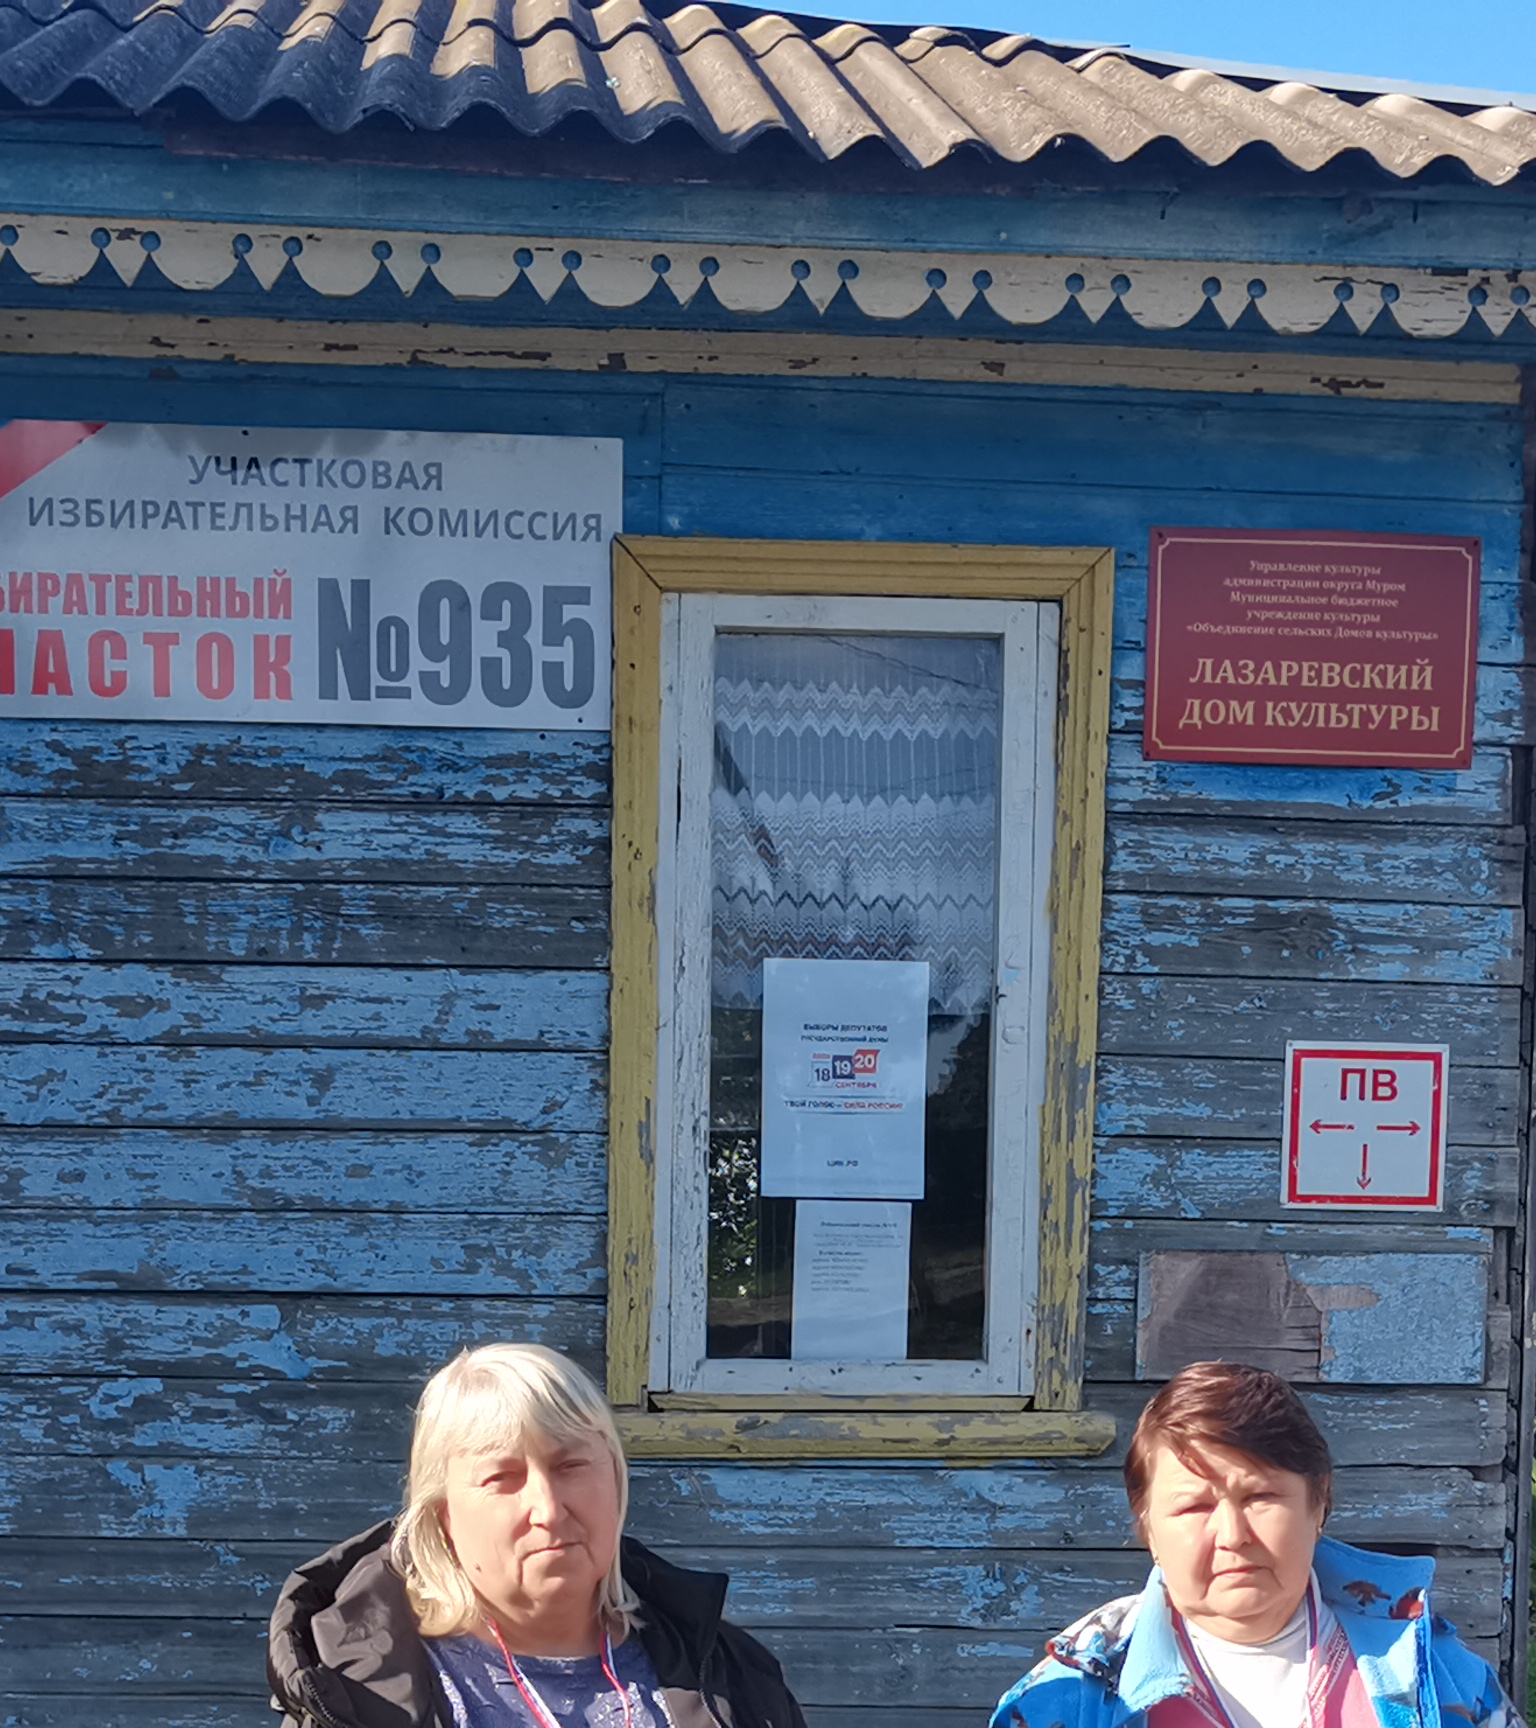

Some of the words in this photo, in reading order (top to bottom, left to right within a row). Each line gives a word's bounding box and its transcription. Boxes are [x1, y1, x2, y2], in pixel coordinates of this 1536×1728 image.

[187, 453, 444, 492] УЧАСТКОВАЯ
[27, 496, 360, 536] ИЗБИРАТЕЛЬНАЯ
[382, 505, 603, 544] КОМИССИЯ
[1223, 577, 1320, 590] администрации
[1322, 580, 1363, 592] округа
[1365, 579, 1406, 593] Муром
[1249, 560, 1322, 574] Управление
[1324, 564, 1382, 577] культуры
[1246, 609, 1322, 621] учреждение
[1323, 612, 1381, 625] культуры
[1330, 594, 1399, 607] бюджетное
[316, 576, 596, 709] №935
[1189, 658, 1434, 691] ЛАЗАРЕВСКИЙ
[1178, 698, 1255, 730] ДОМ
[1264, 701, 1441, 732] КУЛЬТУРЫ
[814, 1068, 831, 1082] 18
[834, 1060, 851, 1075] 19
[854, 1054, 875, 1069] 20
[1340, 1067, 1398, 1101] ПВ
